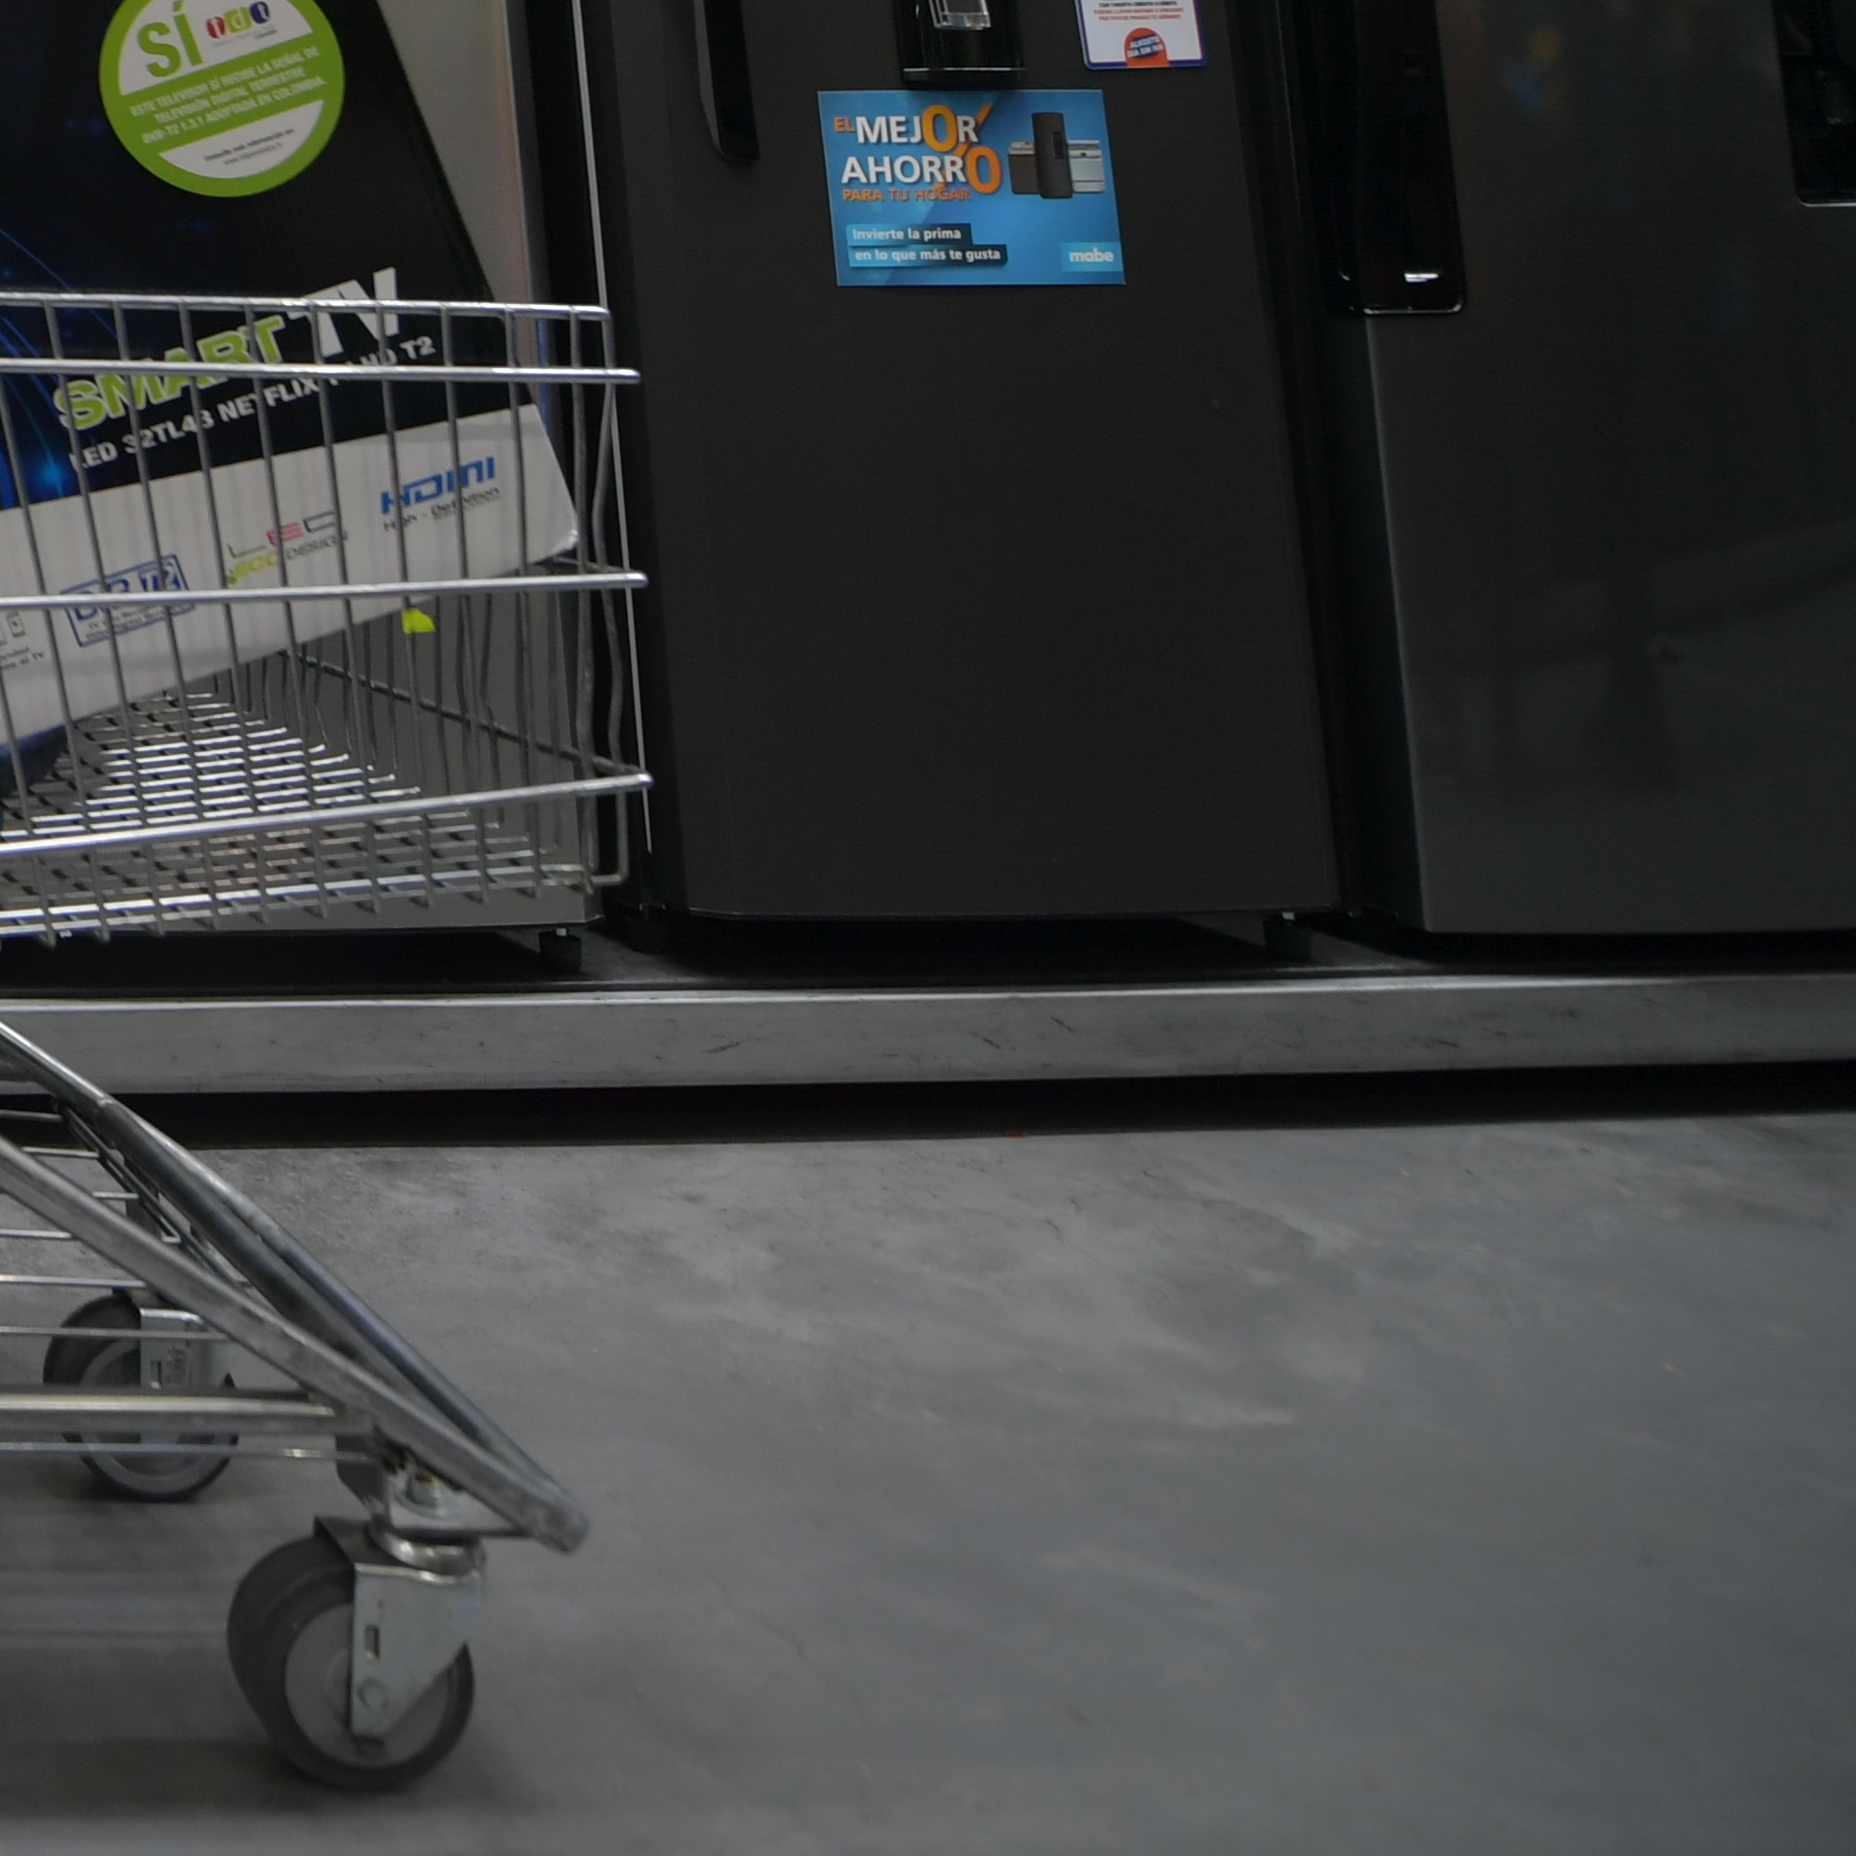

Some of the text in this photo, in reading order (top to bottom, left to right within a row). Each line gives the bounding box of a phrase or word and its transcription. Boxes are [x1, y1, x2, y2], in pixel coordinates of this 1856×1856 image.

[833, 116, 855, 133] EL
[842, 187, 971, 201] PARA TU HOGAR
[852, 227, 962, 244] Invierte la prima
[855, 247, 1001, 263] en que más gusta
[1068, 248, 1115, 263] mabe
[381, 456, 496, 515] HDMI
